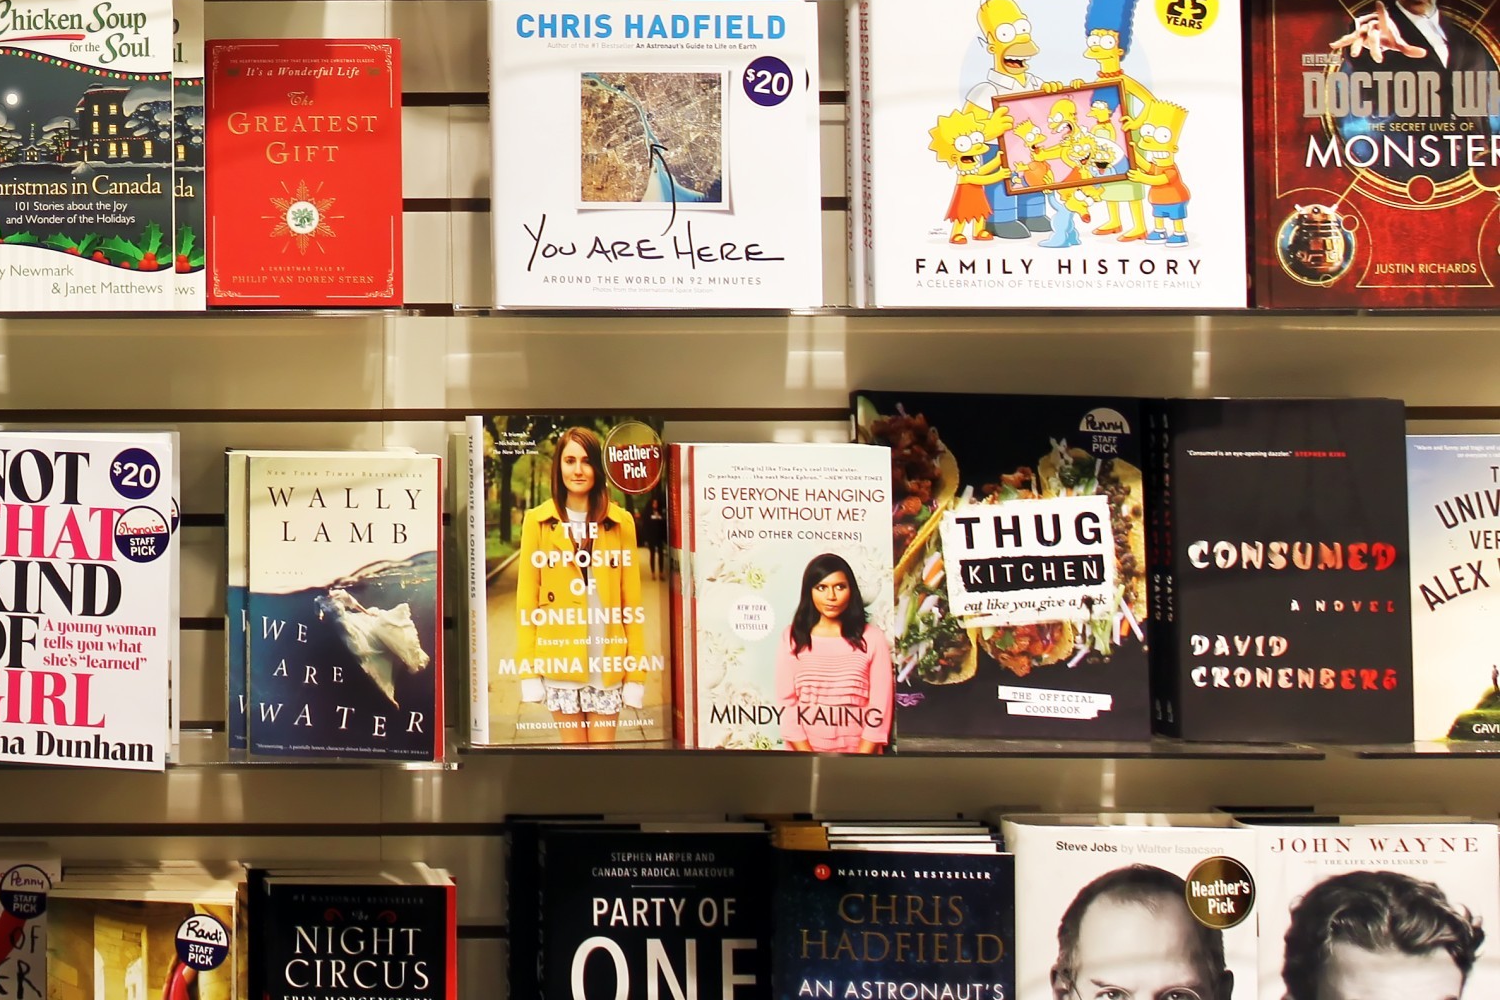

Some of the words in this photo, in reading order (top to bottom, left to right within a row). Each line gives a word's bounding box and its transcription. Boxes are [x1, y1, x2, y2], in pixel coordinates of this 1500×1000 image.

[86, 2, 146, 34] Soup
[516, 14, 612, 38] CHRIS
[625, 15, 786, 40] HADFIELD
[1303, 71, 1441, 120] DOCTOR
[227, 113, 378, 135] GREATEST
[71, 180, 88, 195] in
[92, 174, 162, 195] Canada
[587, 236, 663, 262] ARE
[675, 221, 784, 270] HERE
[915, 258, 1033, 276] FAMILY
[1058, 258, 1201, 276] HISTORY
[1375, 262, 1414, 275] JUSTIN
[1418, 262, 1476, 274] RICHARDS
[267, 486, 421, 510] WALLY
[721, 488, 799, 502] EVERYONE
[805, 487, 884, 502] HANGING
[956, 511, 1102, 550] THUG
[130, 538, 155, 547] STAFF
[130, 546, 156, 556] PICK
[1188, 541, 1396, 571] CONSUMED
[1191, 667, 1396, 690] CRONENBERG
[259, 702, 425, 737] WATER
[710, 706, 785, 726] MINDY
[798, 707, 883, 728] KALING
[1025, 705, 1081, 714] COOKBOOK
[581, 721, 591, 729] BY
[594, 720, 616, 728] ANNE
[618, 719, 654, 727] FADIMAN
[36, 731, 154, 762] Dunham
[1056, 840, 1089, 853] Steve
[1091, 841, 1117, 854] Jobs
[1271, 837, 1350, 854] JOHN
[1369, 837, 1478, 852] WAYNE
[838, 868, 906, 880] NATIONAL
[914, 870, 992, 880] BESTSELLER
[592, 898, 684, 927] PARTY
[699, 898, 735, 927] OF
[294, 927, 421, 957] NIGHT
[800, 929, 1004, 964] HADFIELD
